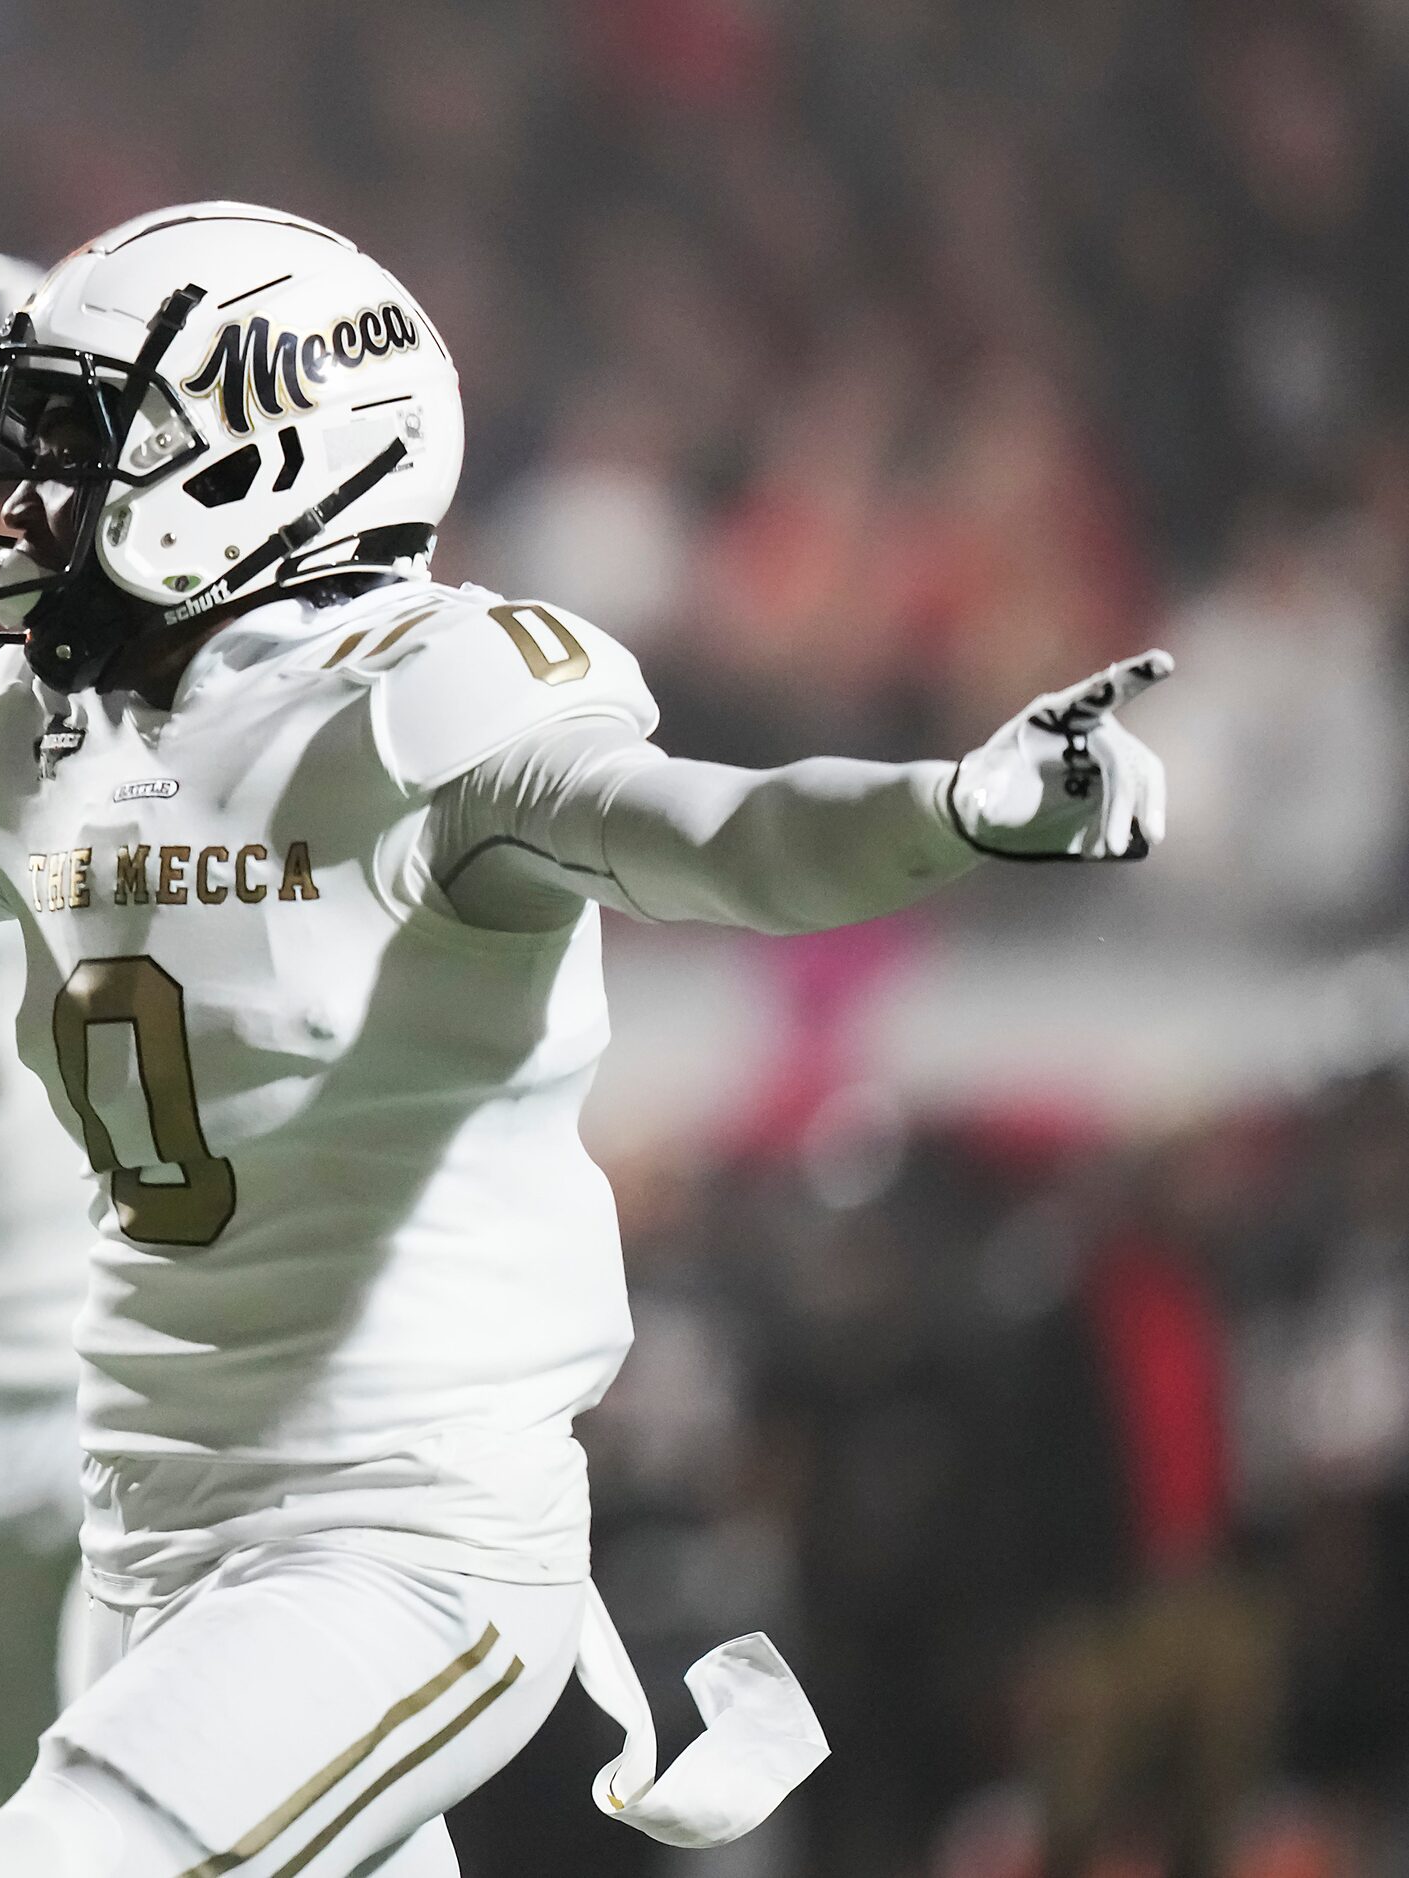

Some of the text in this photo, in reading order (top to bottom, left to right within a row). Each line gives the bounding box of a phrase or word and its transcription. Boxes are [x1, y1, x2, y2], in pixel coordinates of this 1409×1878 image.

[180, 301, 421, 439] Mecca
[164, 579, 232, 625] schutt
[488, 604, 591, 686] 0
[29, 841, 320, 912] THE MECCA
[52, 954, 236, 1247] 0
